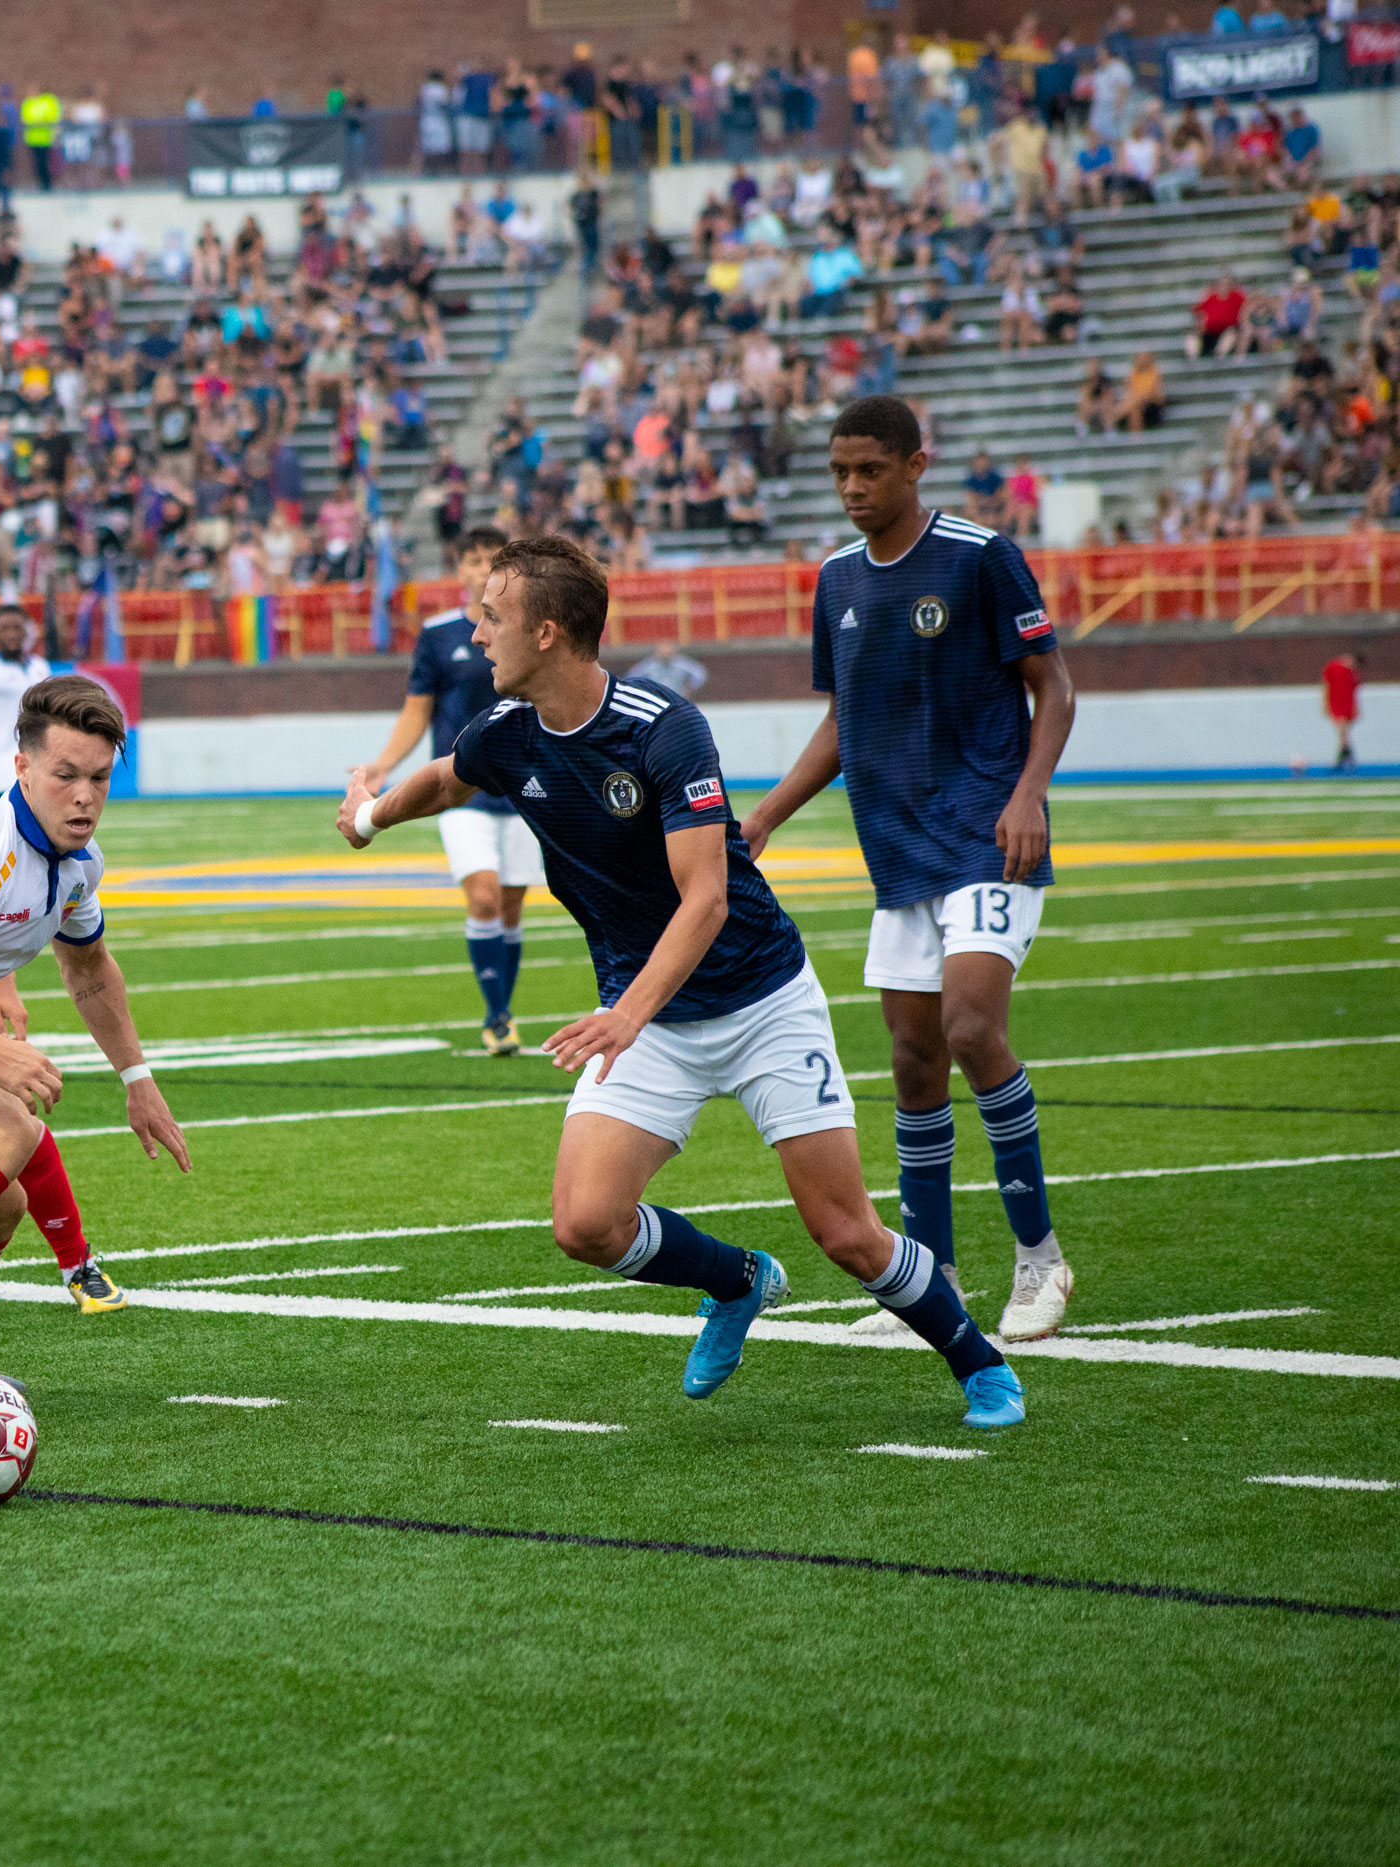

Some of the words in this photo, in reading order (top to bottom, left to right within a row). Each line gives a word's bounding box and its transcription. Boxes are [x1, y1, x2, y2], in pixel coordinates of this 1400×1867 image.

[521, 789, 547, 798] adidas
[972, 887, 1011, 935] 13
[803, 1050, 840, 1107] 2
